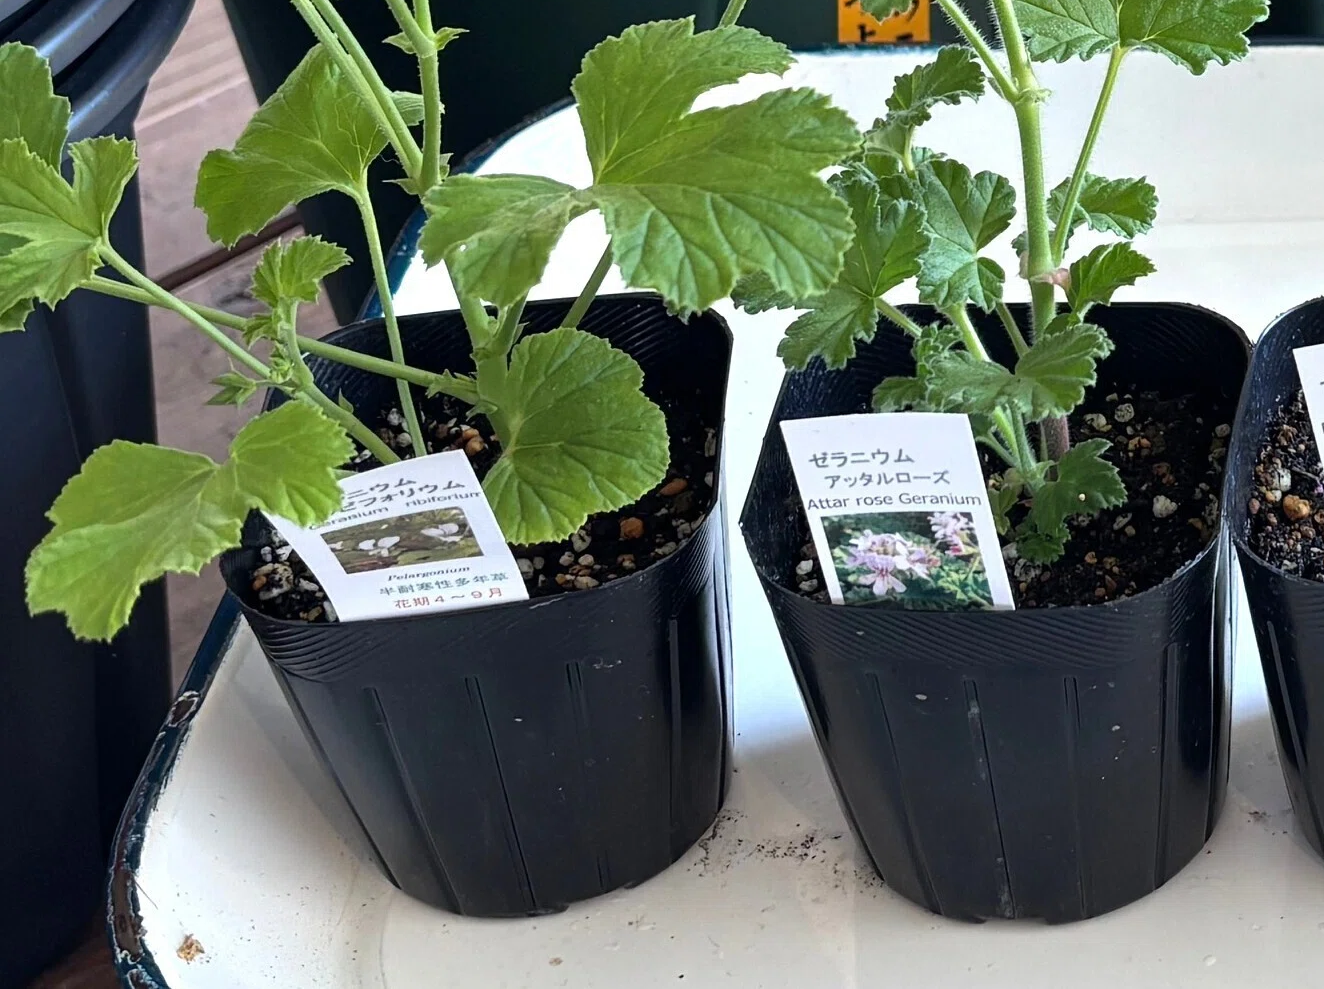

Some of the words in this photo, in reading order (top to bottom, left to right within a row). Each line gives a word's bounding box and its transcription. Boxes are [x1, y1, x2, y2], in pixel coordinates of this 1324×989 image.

[808, 448, 915, 468] ゼラニウム
[824, 469, 951, 489] アッタルローズ
[332, 480, 466, 515] ビフォリウム
[807, 498, 850, 511] Attar
[856, 494, 893, 506] rose
[899, 492, 983, 507] Geranium
[387, 566, 470, 581] Pelargonium
[380, 572, 509, 596] 半耐寒性多年草
